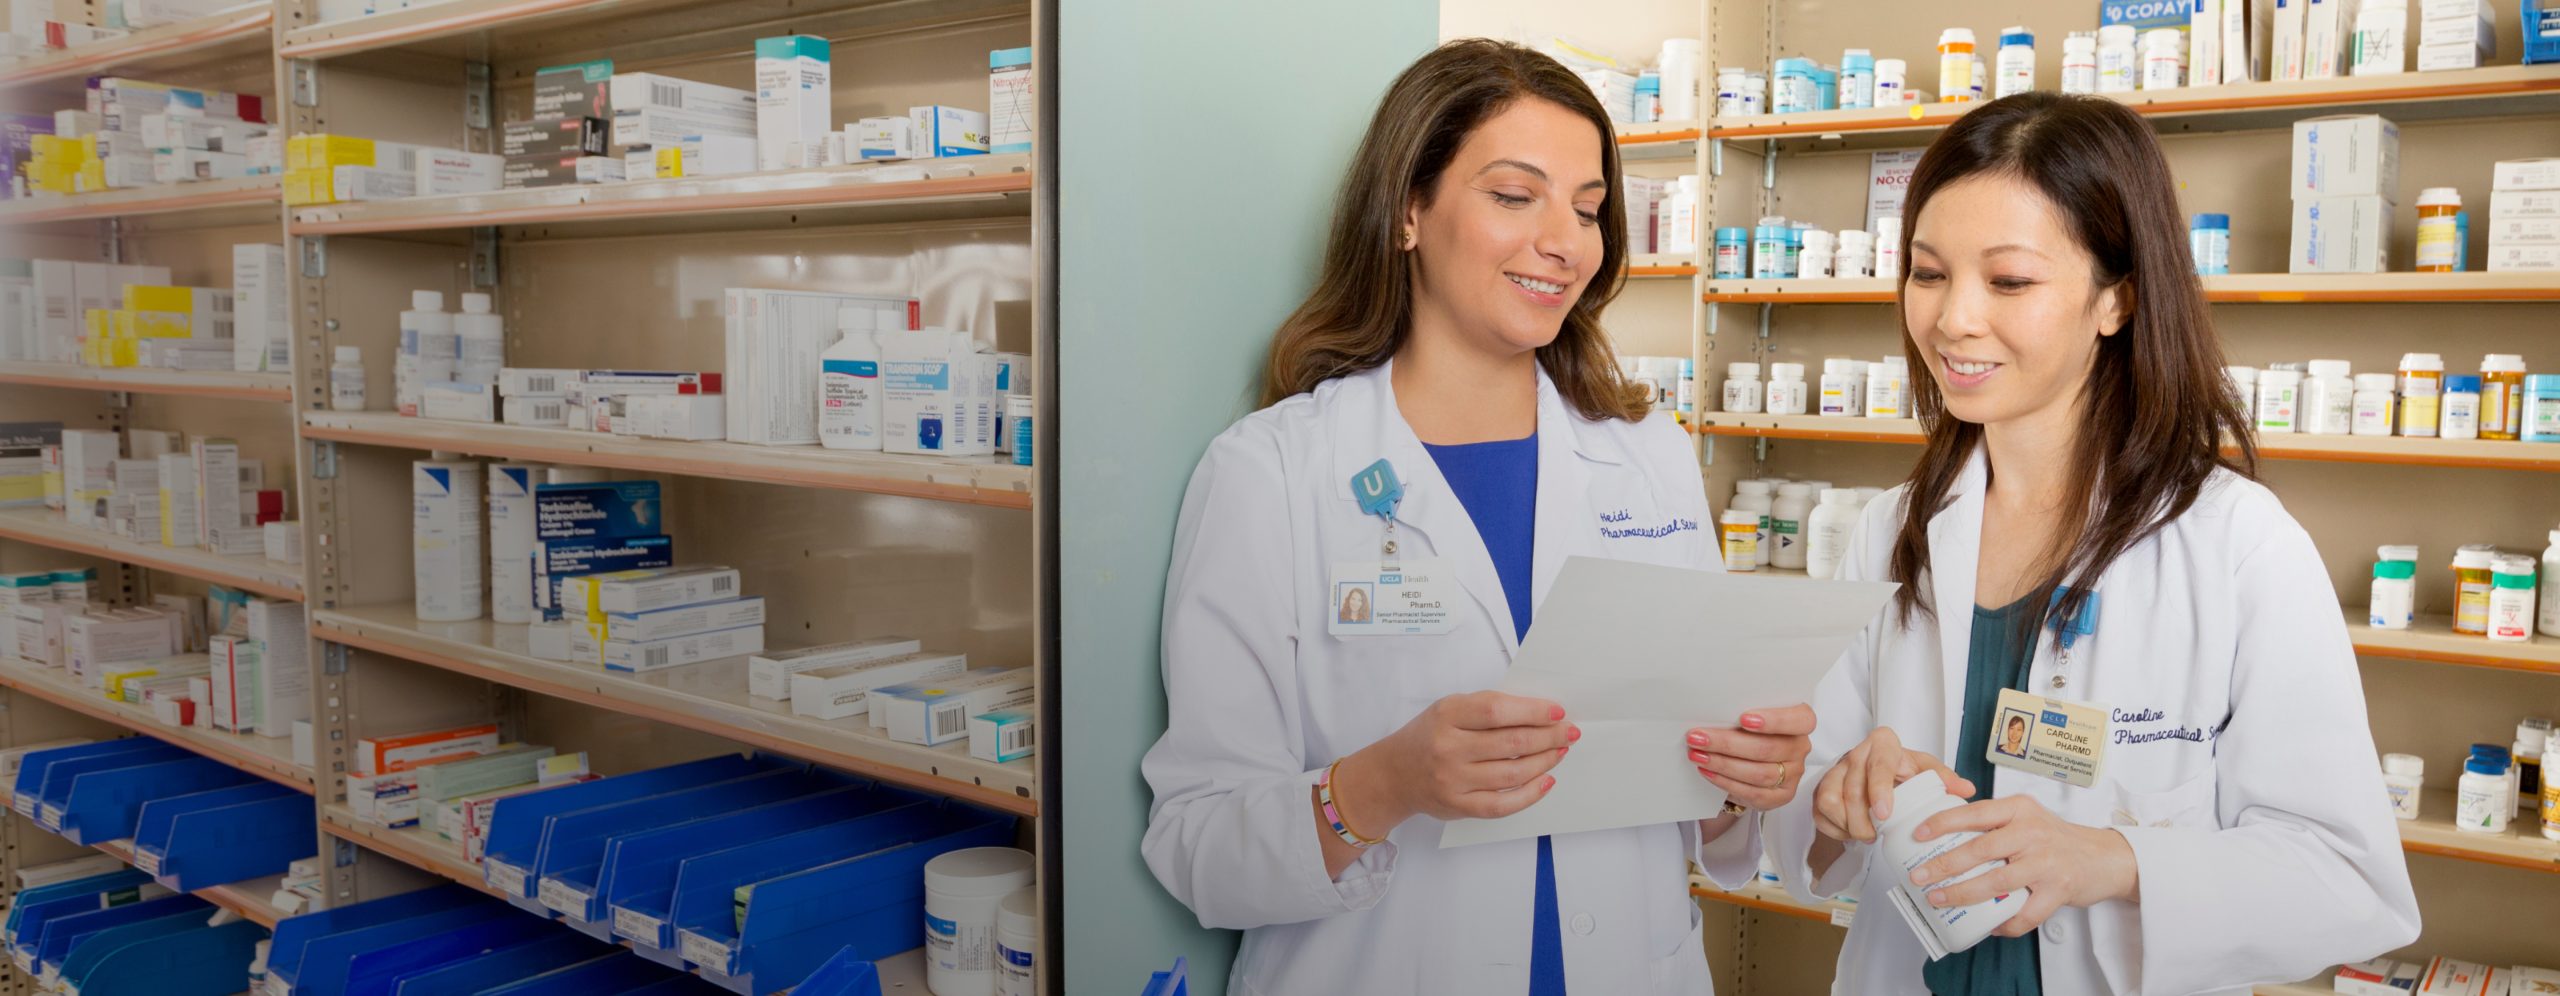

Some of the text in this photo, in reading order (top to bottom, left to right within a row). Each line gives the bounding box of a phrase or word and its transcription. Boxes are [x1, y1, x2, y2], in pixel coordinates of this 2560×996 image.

[1876, 176, 1895, 185] NO
[1363, 470, 1384, 497] U
[1600, 509, 1632, 523] Heidi
[1600, 519, 1681, 539] Pharmaceutical
[1382, 575, 1400, 583] UCLA
[1401, 591, 1422, 599] HEIDI
[2043, 713, 2065, 723] UCLA
[2112, 708, 2164, 723] Caroline
[2046, 728, 2089, 745] CAROLINE
[2115, 724, 2205, 744] Pharmaceutical
[2055, 740, 2092, 756] PHARMD
[2029, 755, 2093, 777] Pharmaceutical Services
